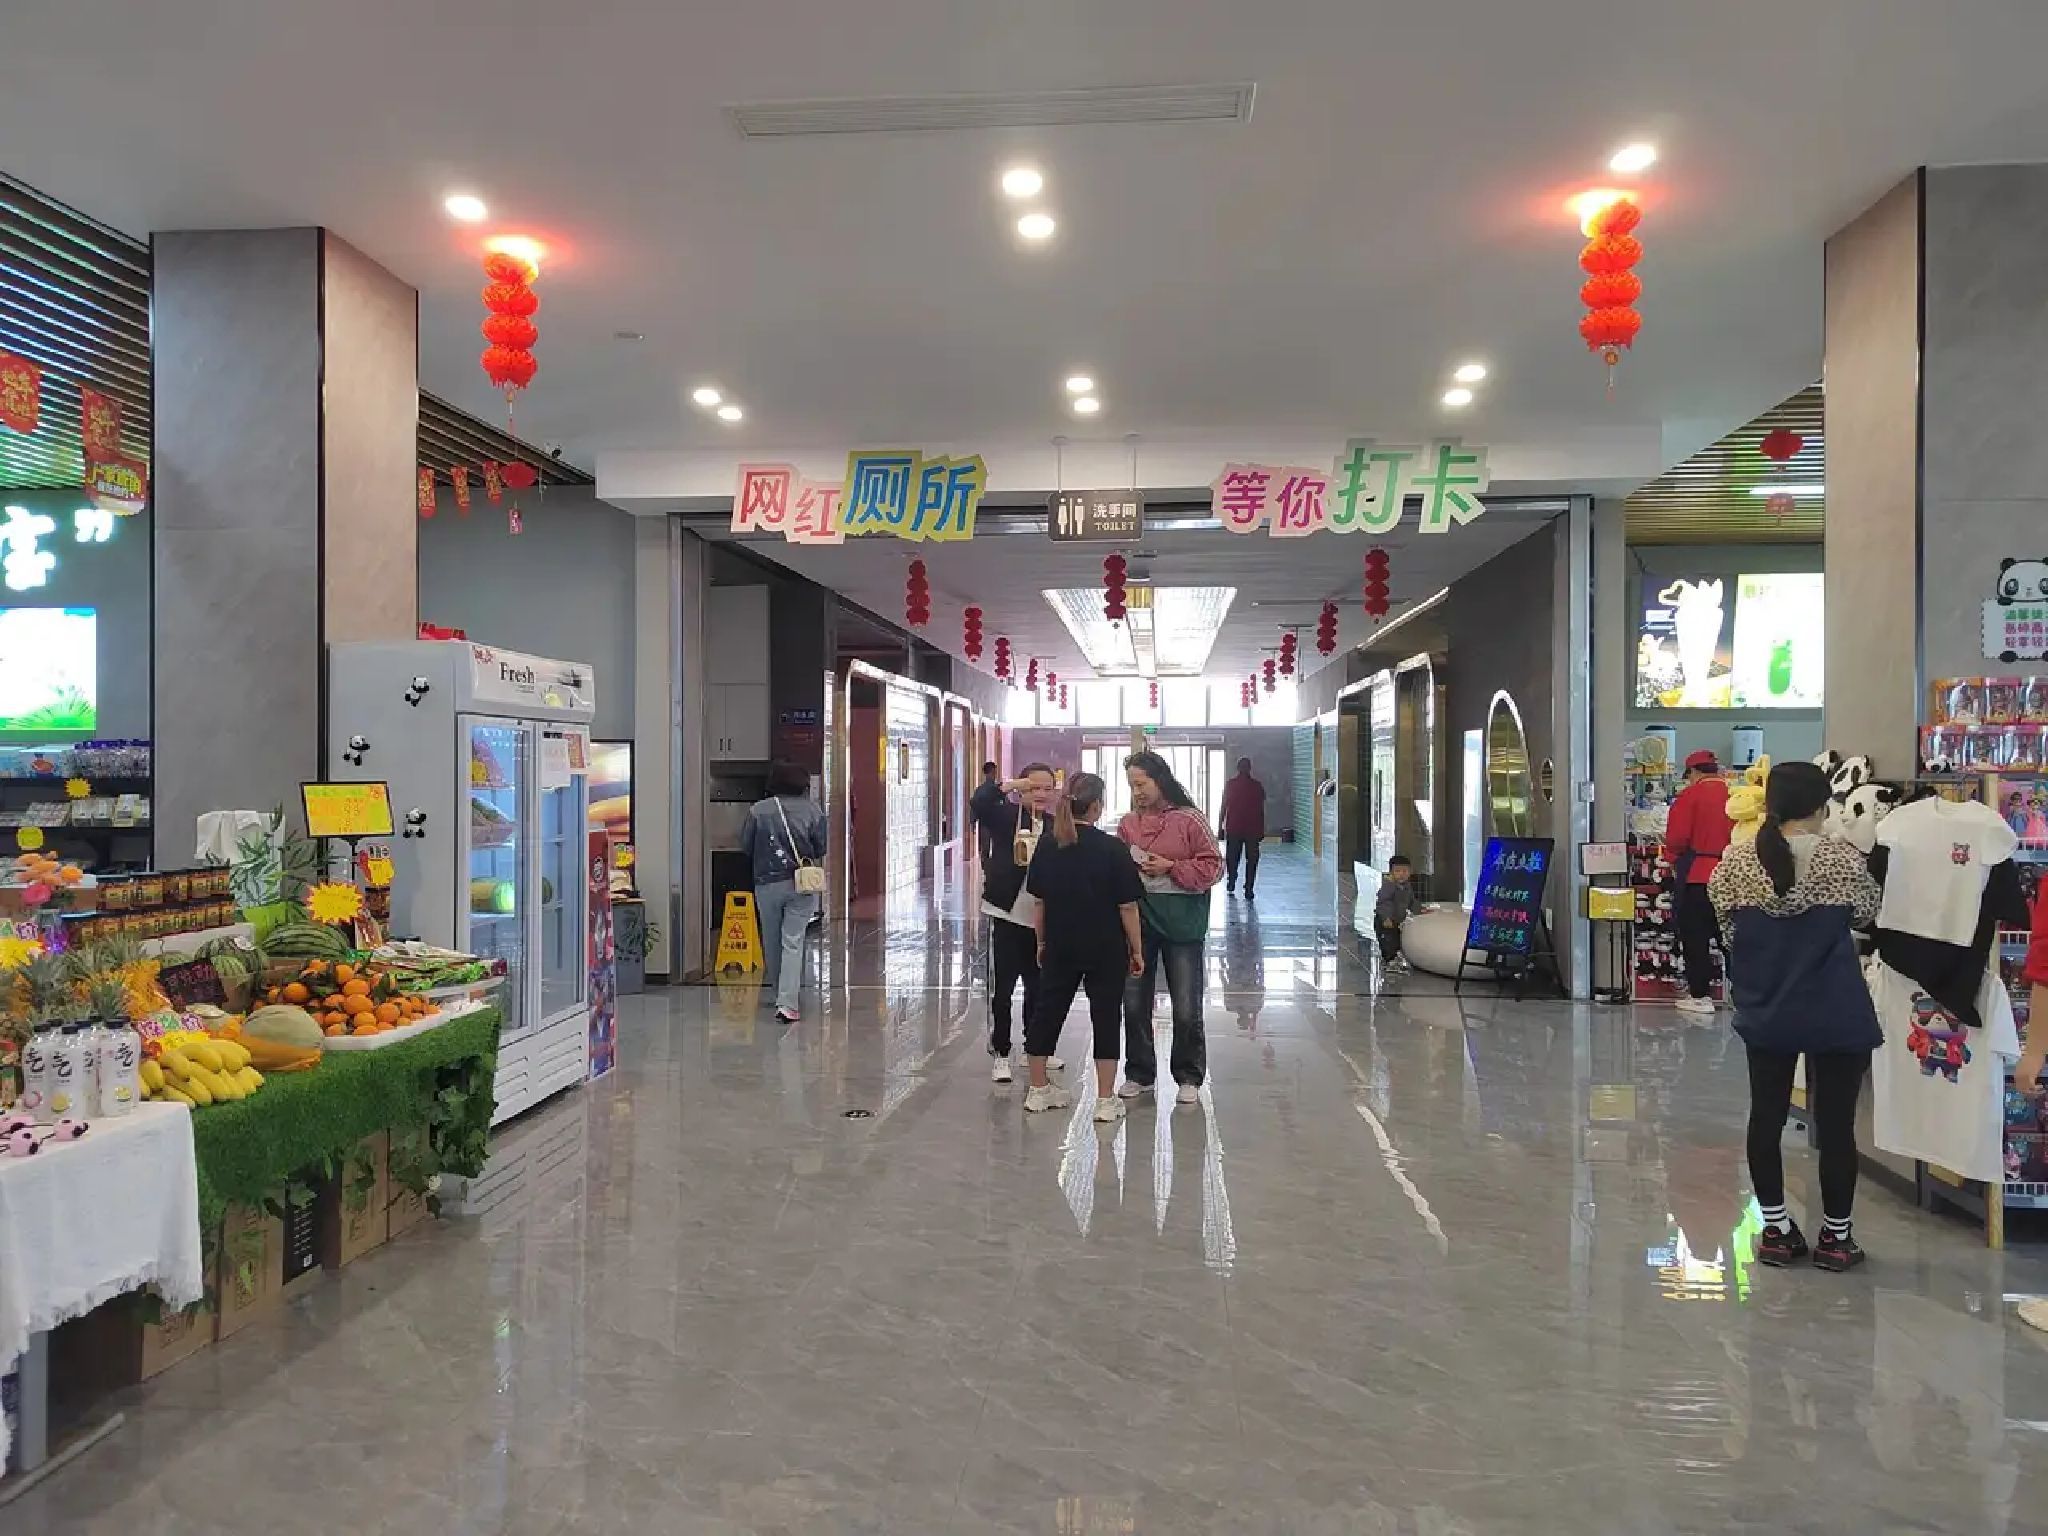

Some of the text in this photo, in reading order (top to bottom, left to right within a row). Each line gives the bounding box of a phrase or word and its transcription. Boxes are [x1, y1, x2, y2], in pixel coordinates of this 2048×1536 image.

[1222, 445, 1479, 529] 等你打卡
[741, 458, 976, 536] 网红厕所
[1092, 503, 1137, 518] 洗手间
[1094, 521, 1134, 531] TOILET
[2005, 636, 2048, 648] 轻拿轻
[499, 662, 535, 685] Fresh
